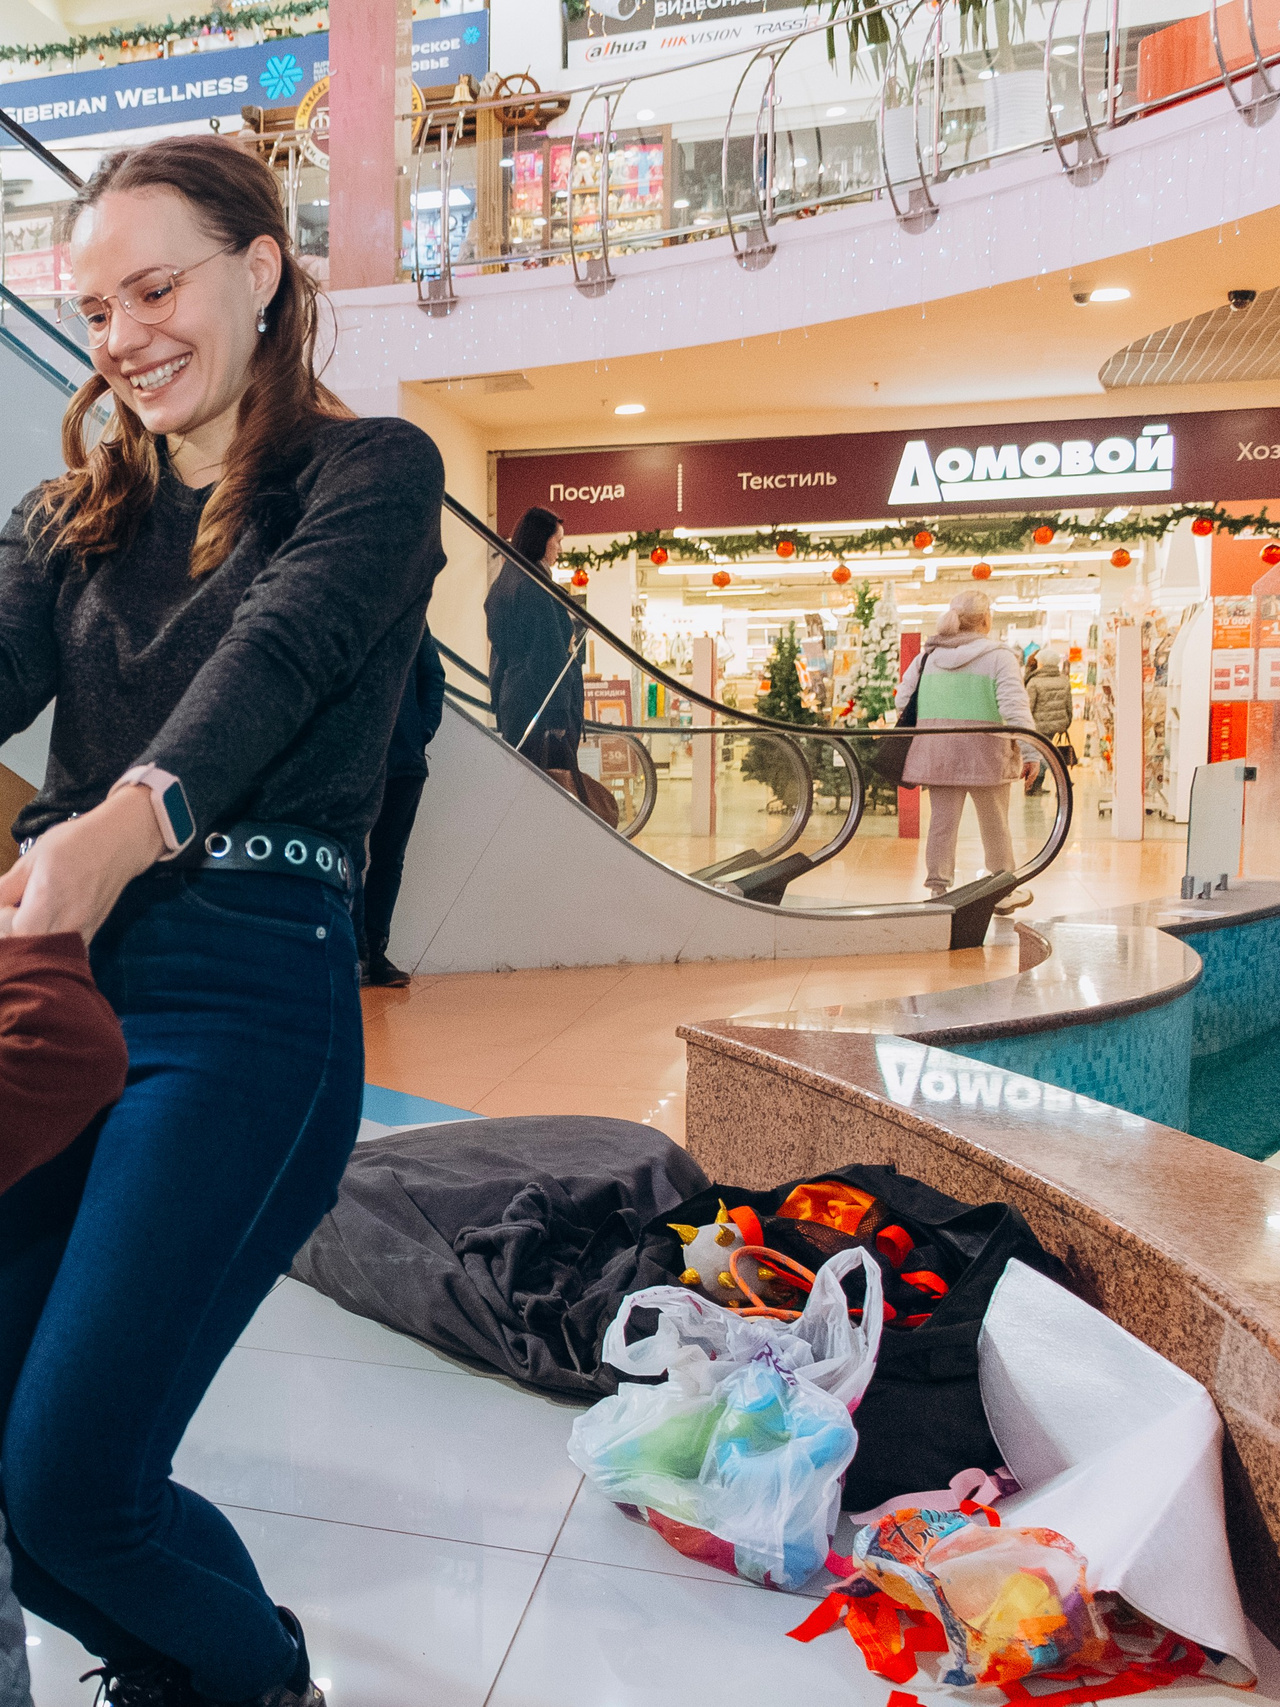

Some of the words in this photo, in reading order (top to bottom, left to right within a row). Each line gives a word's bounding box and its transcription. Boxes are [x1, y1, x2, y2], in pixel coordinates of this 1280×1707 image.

[412, 38, 461, 56] РСКОЕ
[660, 27, 743, 49] HIKVISION
[412, 56, 450, 73] ОВЬЕ
[5, 95, 107, 125] SIBERIAN
[115, 75, 249, 110] WELLNESS
[888, 424, 1174, 505] ДОМОВОЙ
[737, 471, 838, 491] Текстиль
[549, 483, 626, 504] Посуда
